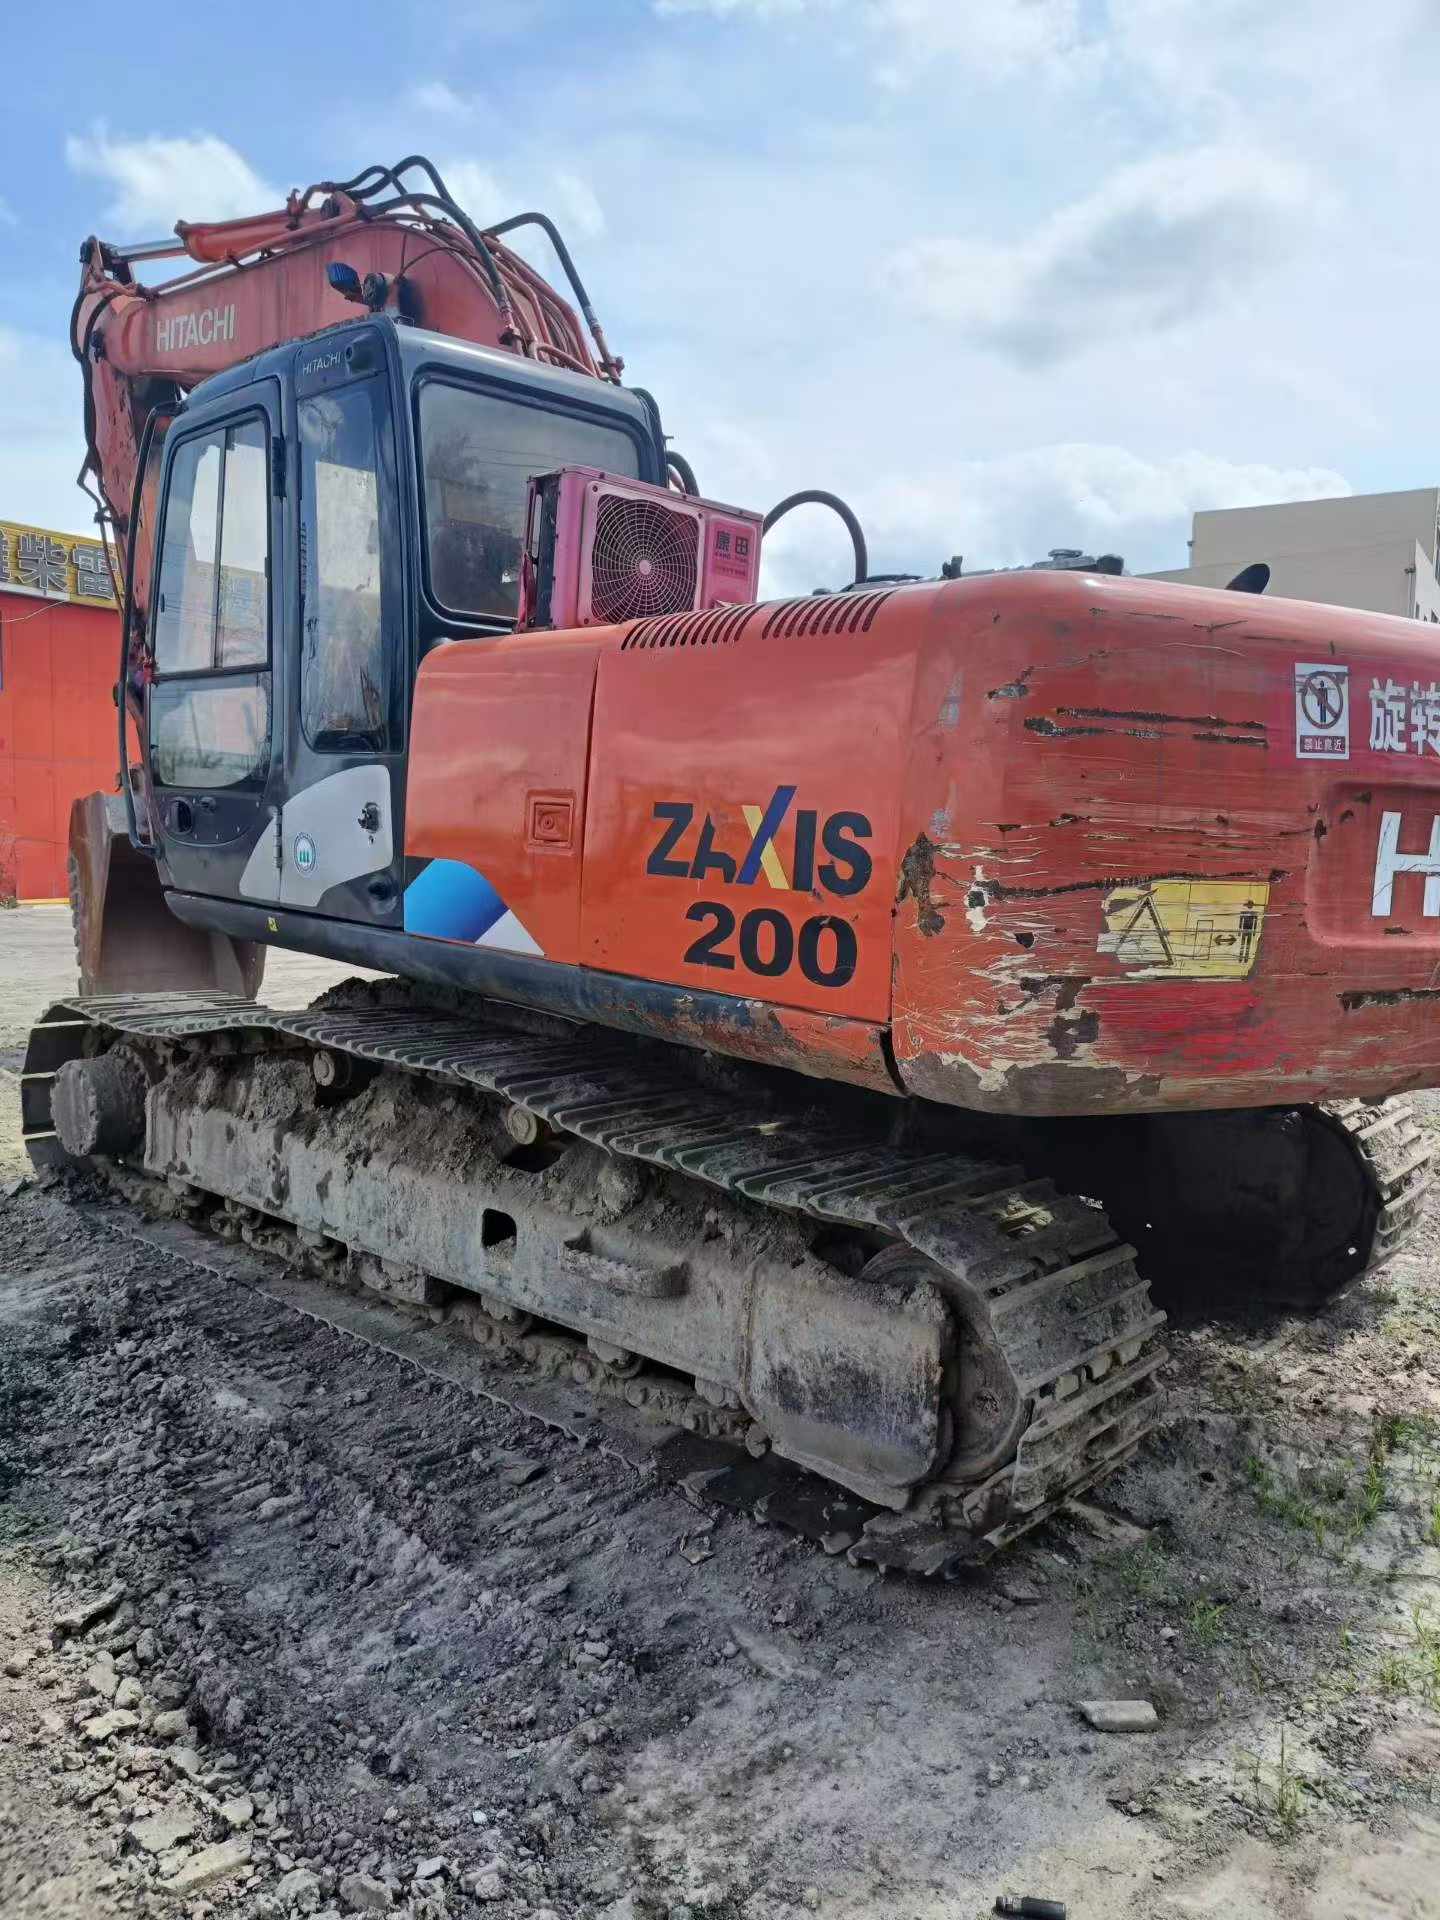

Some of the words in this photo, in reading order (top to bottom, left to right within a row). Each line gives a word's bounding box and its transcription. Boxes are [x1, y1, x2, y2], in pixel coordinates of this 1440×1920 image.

[156, 303, 236, 352] HITACHI
[302, 351, 341, 376] HITACHI
[0, 526, 119, 600] 柴雷
[646, 785, 873, 896] ZAXIS
[683, 901, 858, 988] 200
